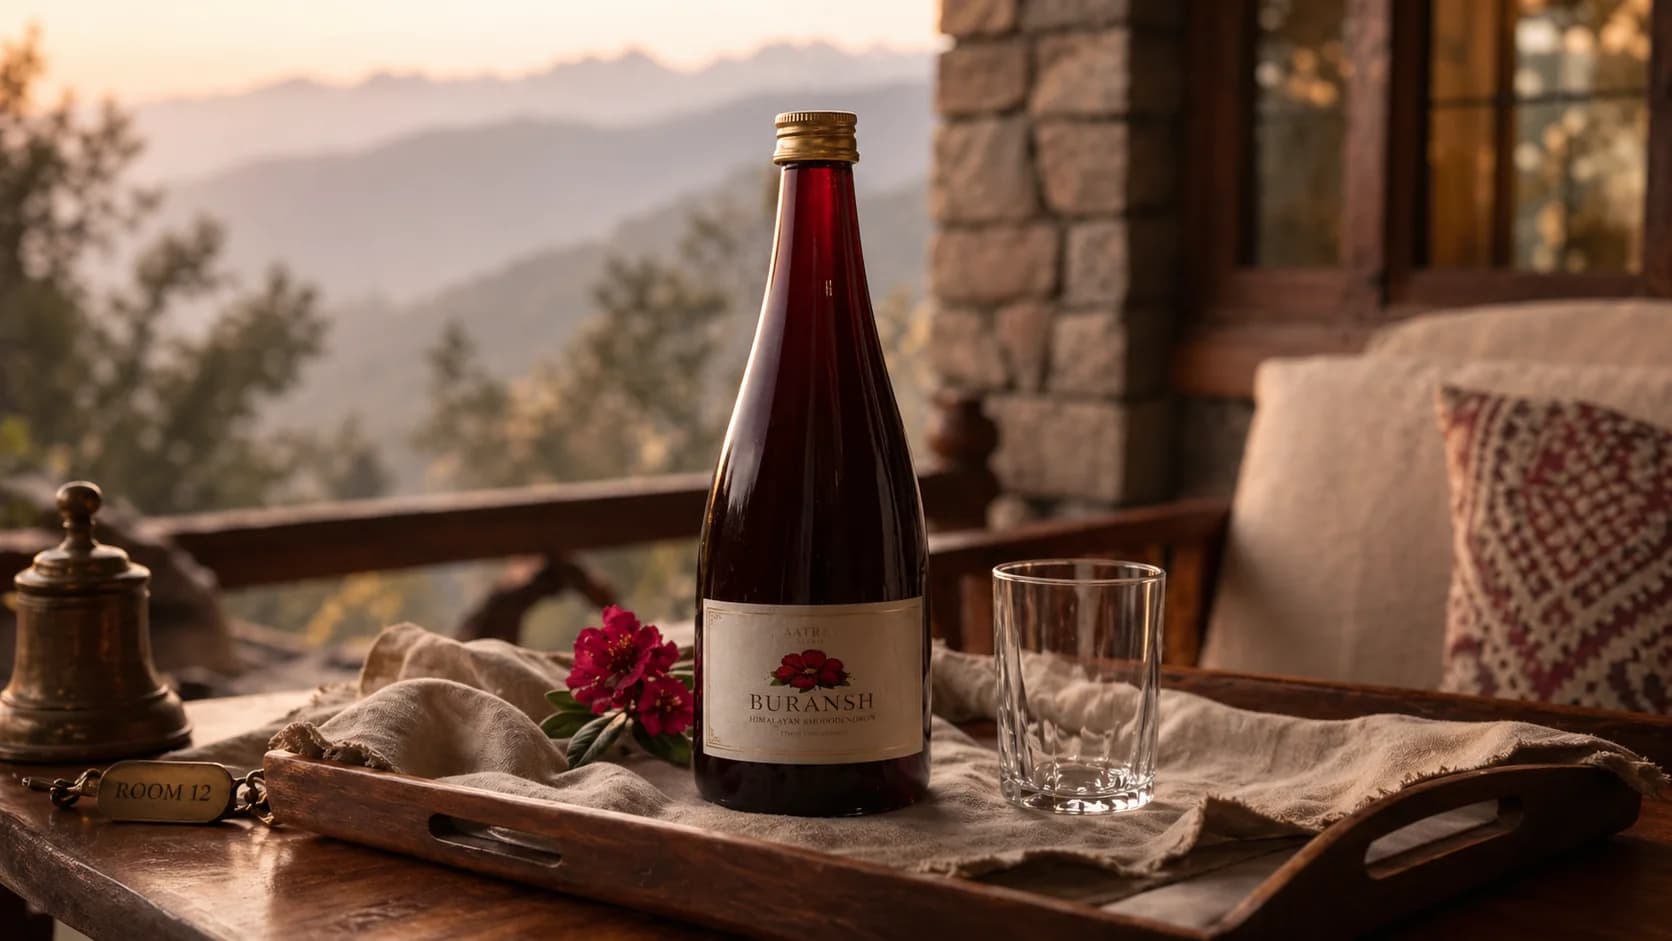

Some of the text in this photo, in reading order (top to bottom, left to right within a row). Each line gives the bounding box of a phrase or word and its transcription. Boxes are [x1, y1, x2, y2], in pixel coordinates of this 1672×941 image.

[750, 693, 873, 712] BURANSH
[749, 714, 800, 726] HIMALAYAN
[114, 781, 212, 801] ROOM 12
